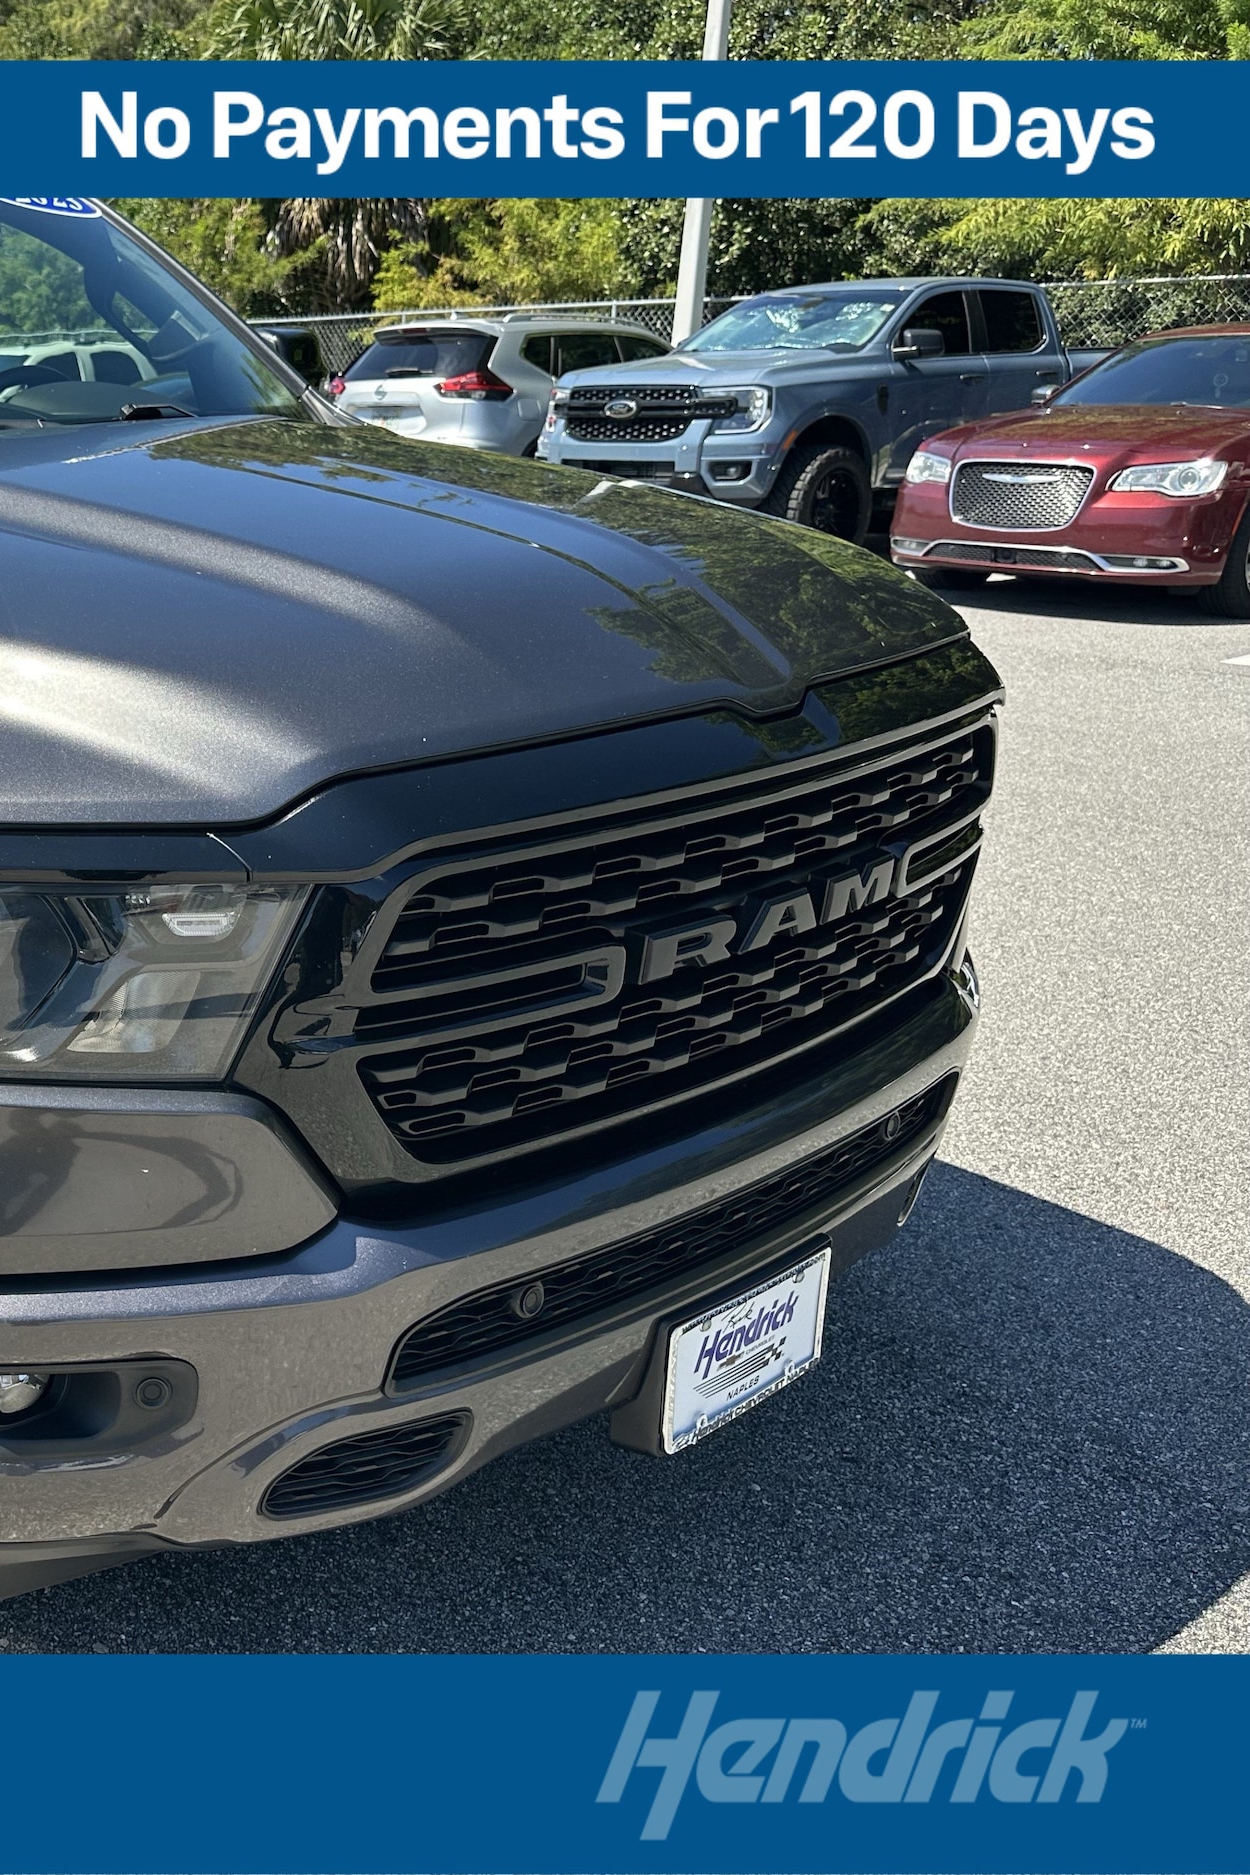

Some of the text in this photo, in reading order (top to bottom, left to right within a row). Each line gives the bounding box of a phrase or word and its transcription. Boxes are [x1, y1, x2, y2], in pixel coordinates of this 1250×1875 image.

[637, 855, 895, 985] RAM
[693, 1290, 799, 1380] Hendrick
[726, 1375, 760, 1401] NAPLES
[734, 1378, 785, 1416] CHEVROLET
